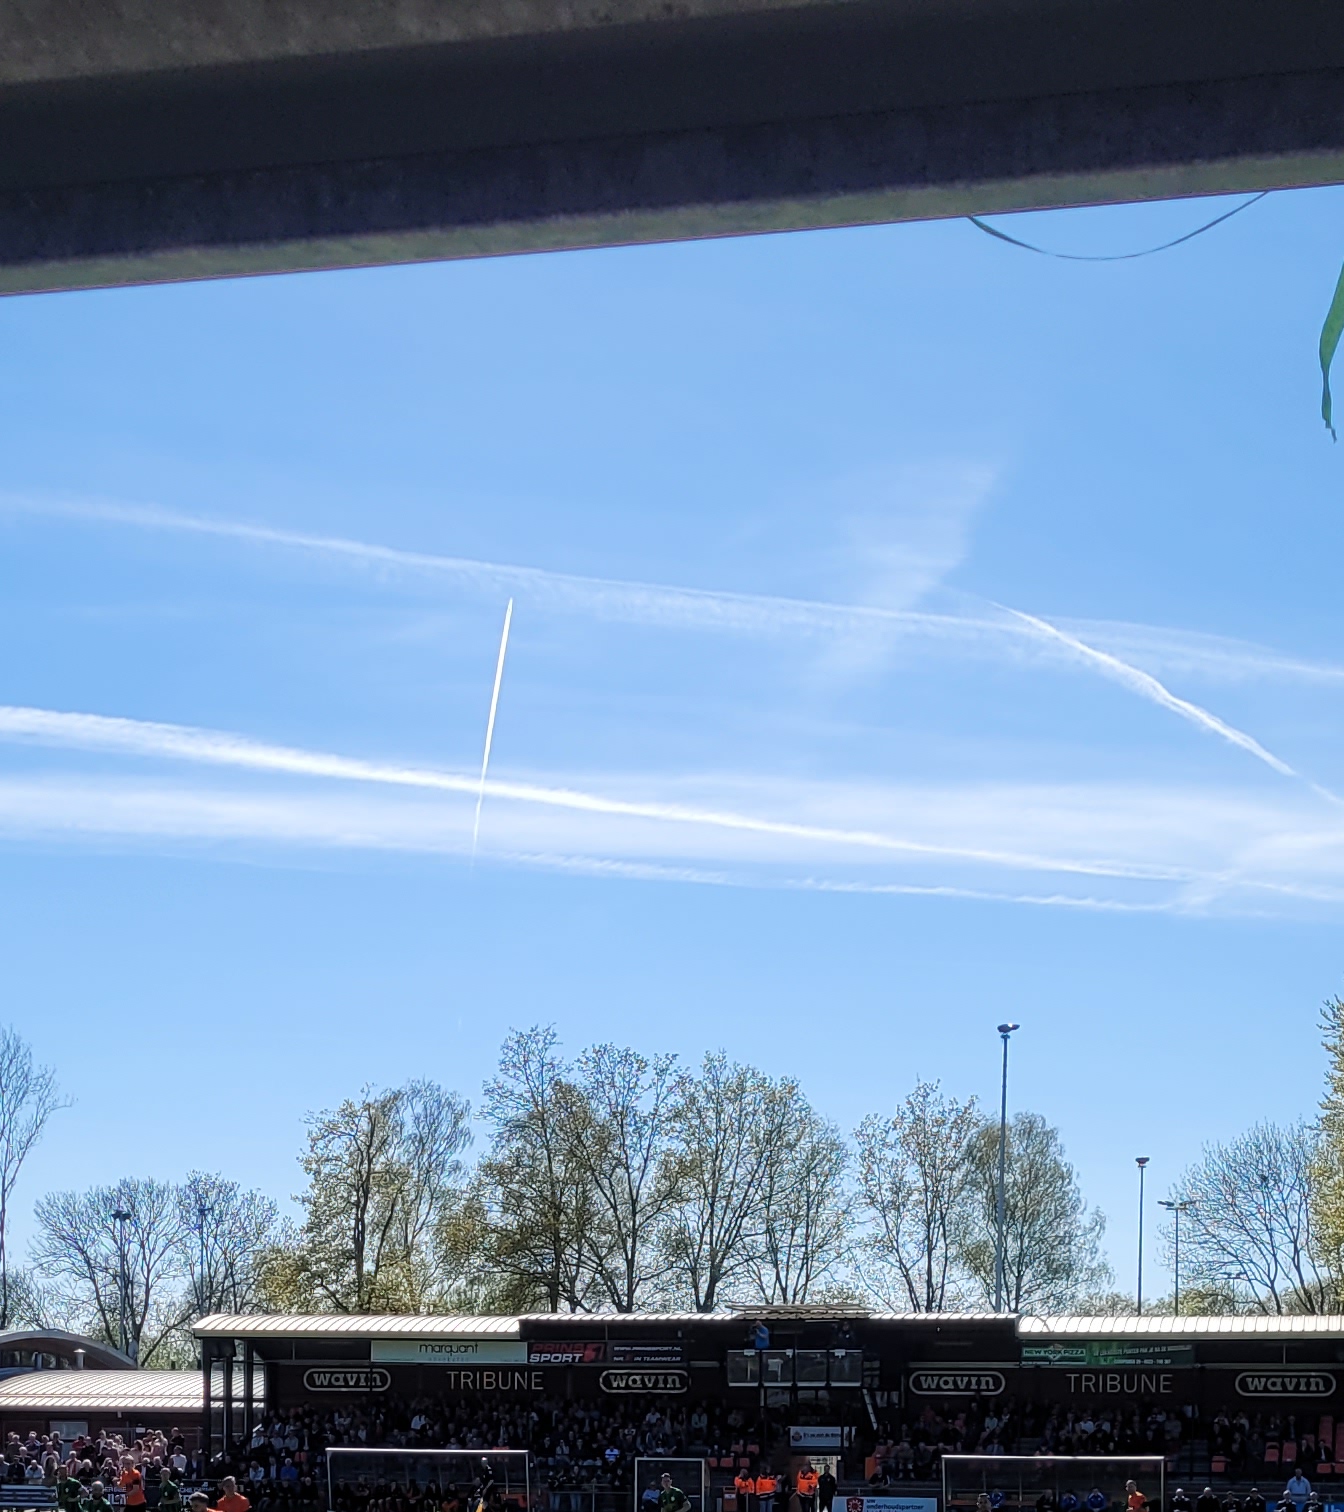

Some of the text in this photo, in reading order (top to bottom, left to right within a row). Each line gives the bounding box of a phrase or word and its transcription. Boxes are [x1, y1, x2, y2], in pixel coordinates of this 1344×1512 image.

[529, 1353, 584, 1363] SPORT
[446, 1371, 544, 1390] TRIBUNE
[609, 1375, 681, 1388] wavin
[919, 1375, 995, 1389] wavin
[1065, 1374, 1173, 1393] TRIBUNE
[1245, 1377, 1325, 1391] wavin
